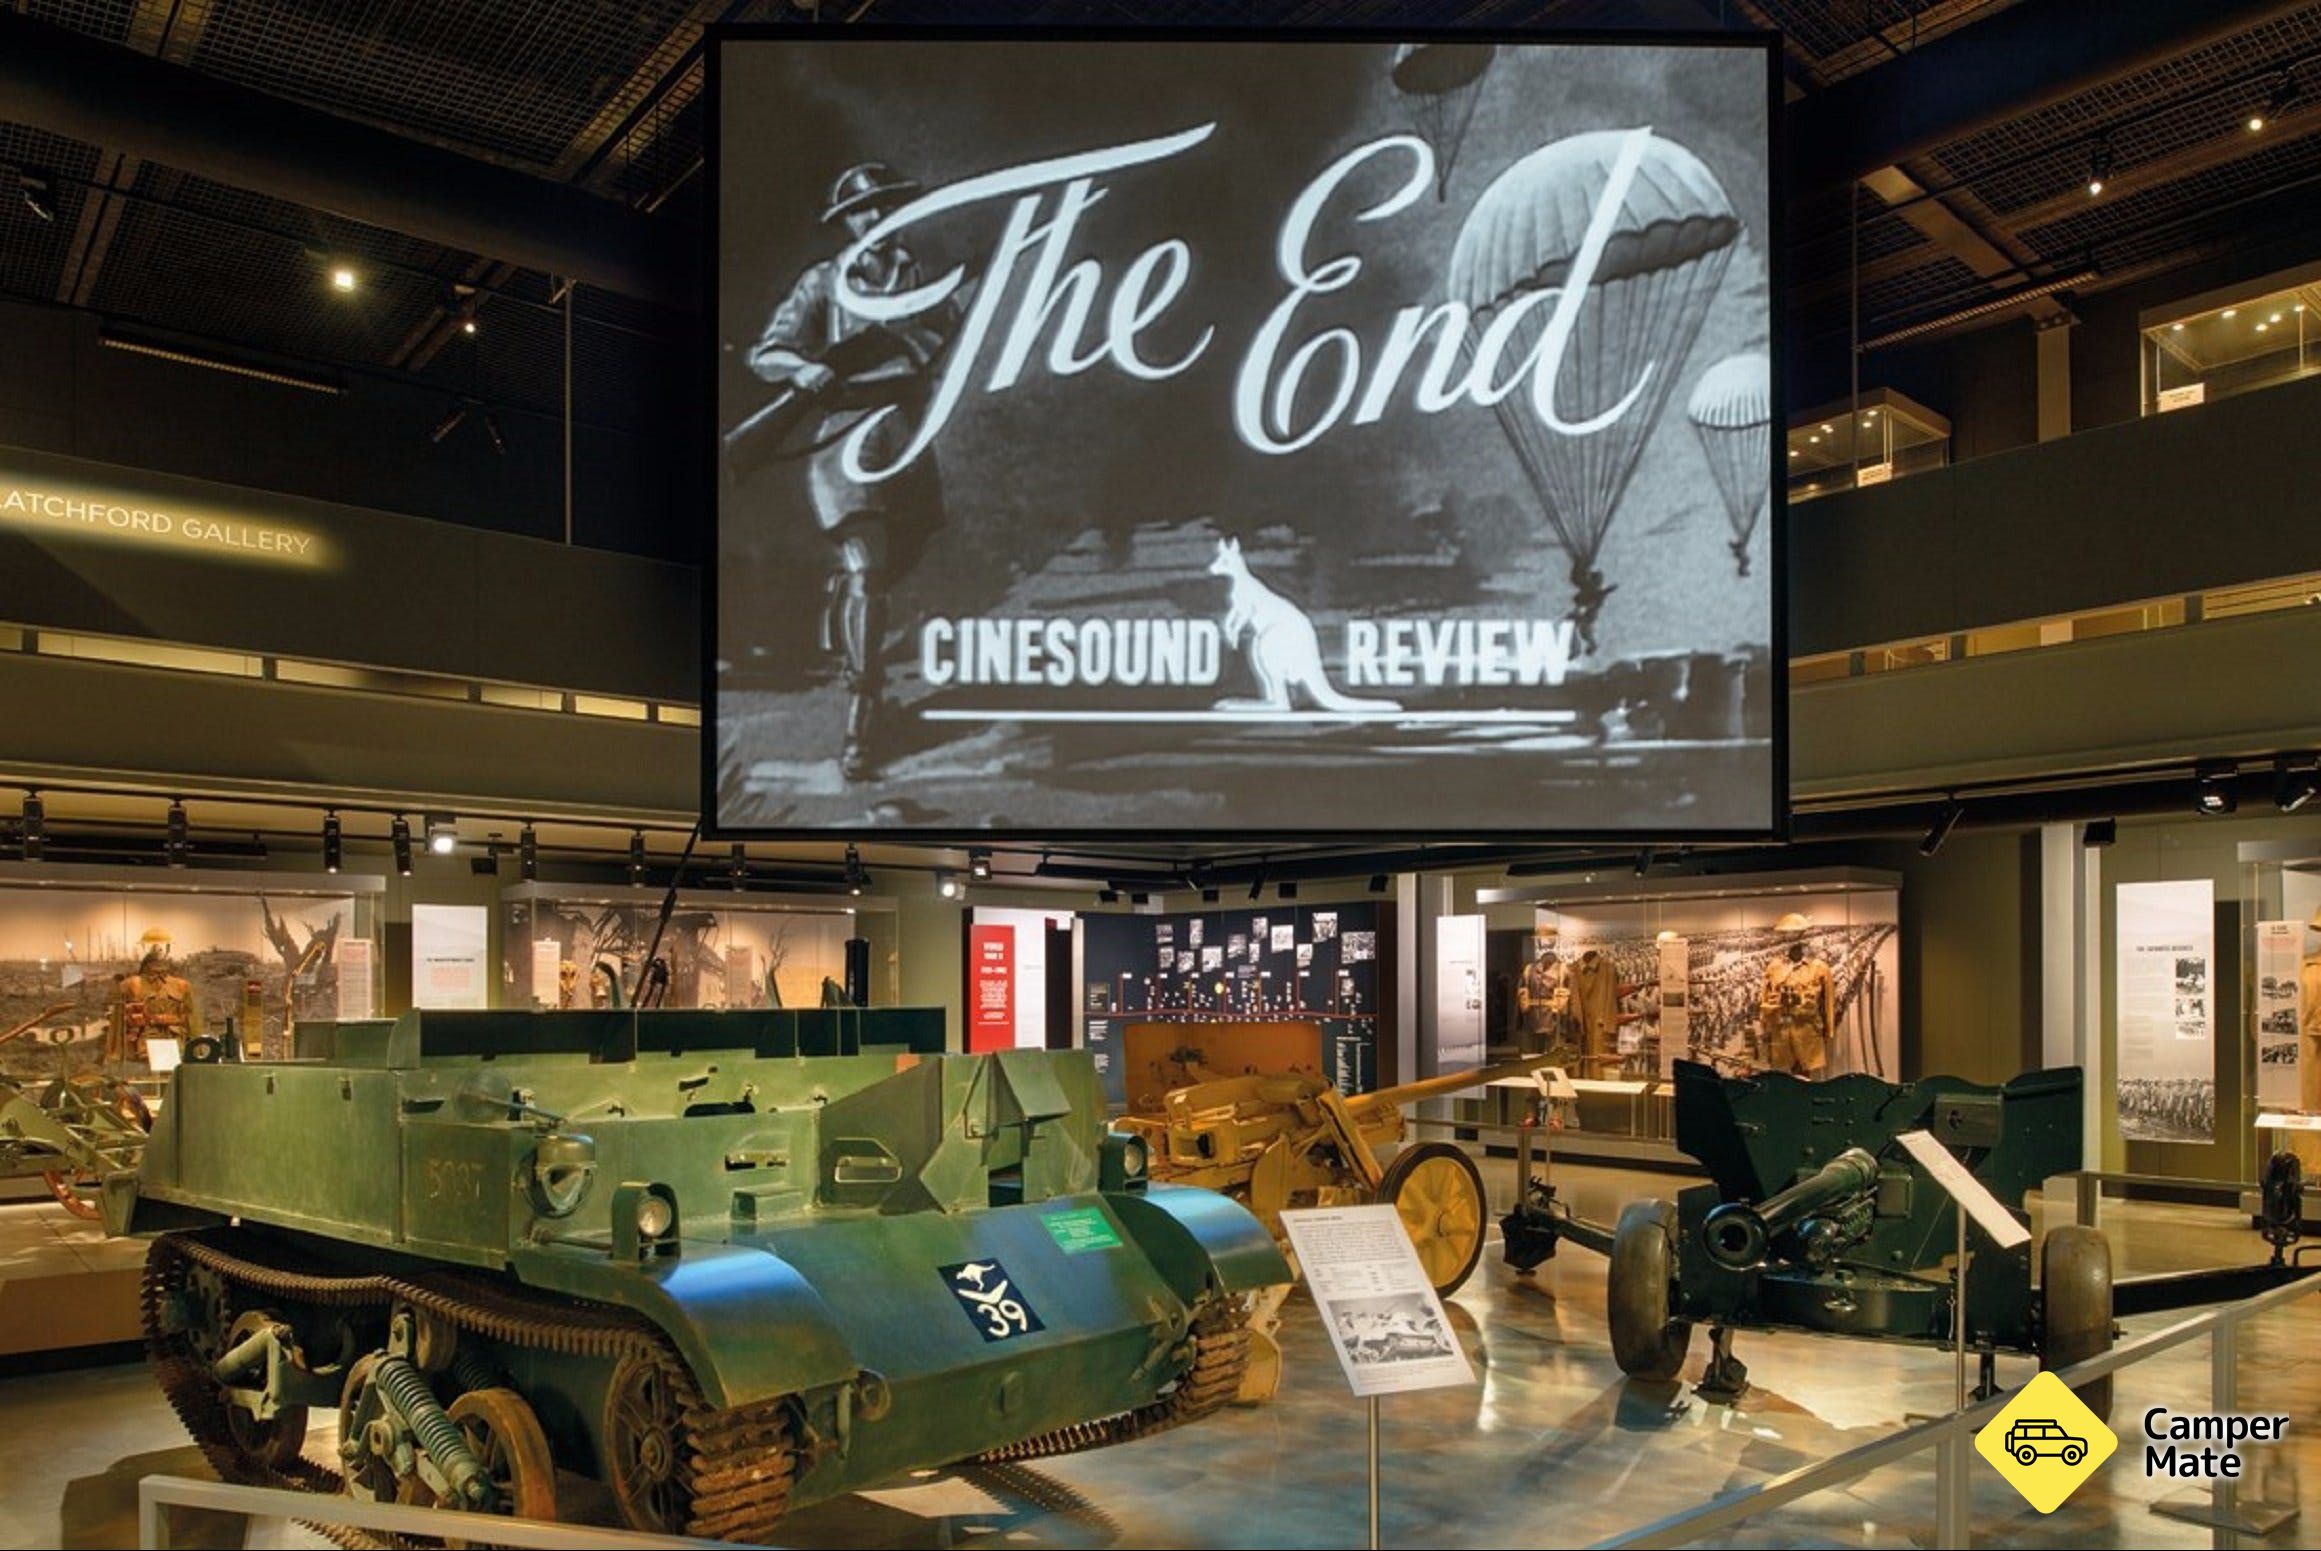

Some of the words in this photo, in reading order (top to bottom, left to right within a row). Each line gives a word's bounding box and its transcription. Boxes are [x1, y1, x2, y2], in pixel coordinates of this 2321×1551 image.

[839, 122, 1216, 483] The
[1234, 126, 1655, 455] End
[0, 490, 172, 533] ATCHFORD
[182, 517, 311, 554] GALLERY
[922, 617, 1221, 685] CINESOUND
[1347, 619, 1575, 686] REVIEW
[977, 1299, 1027, 1337] 39
